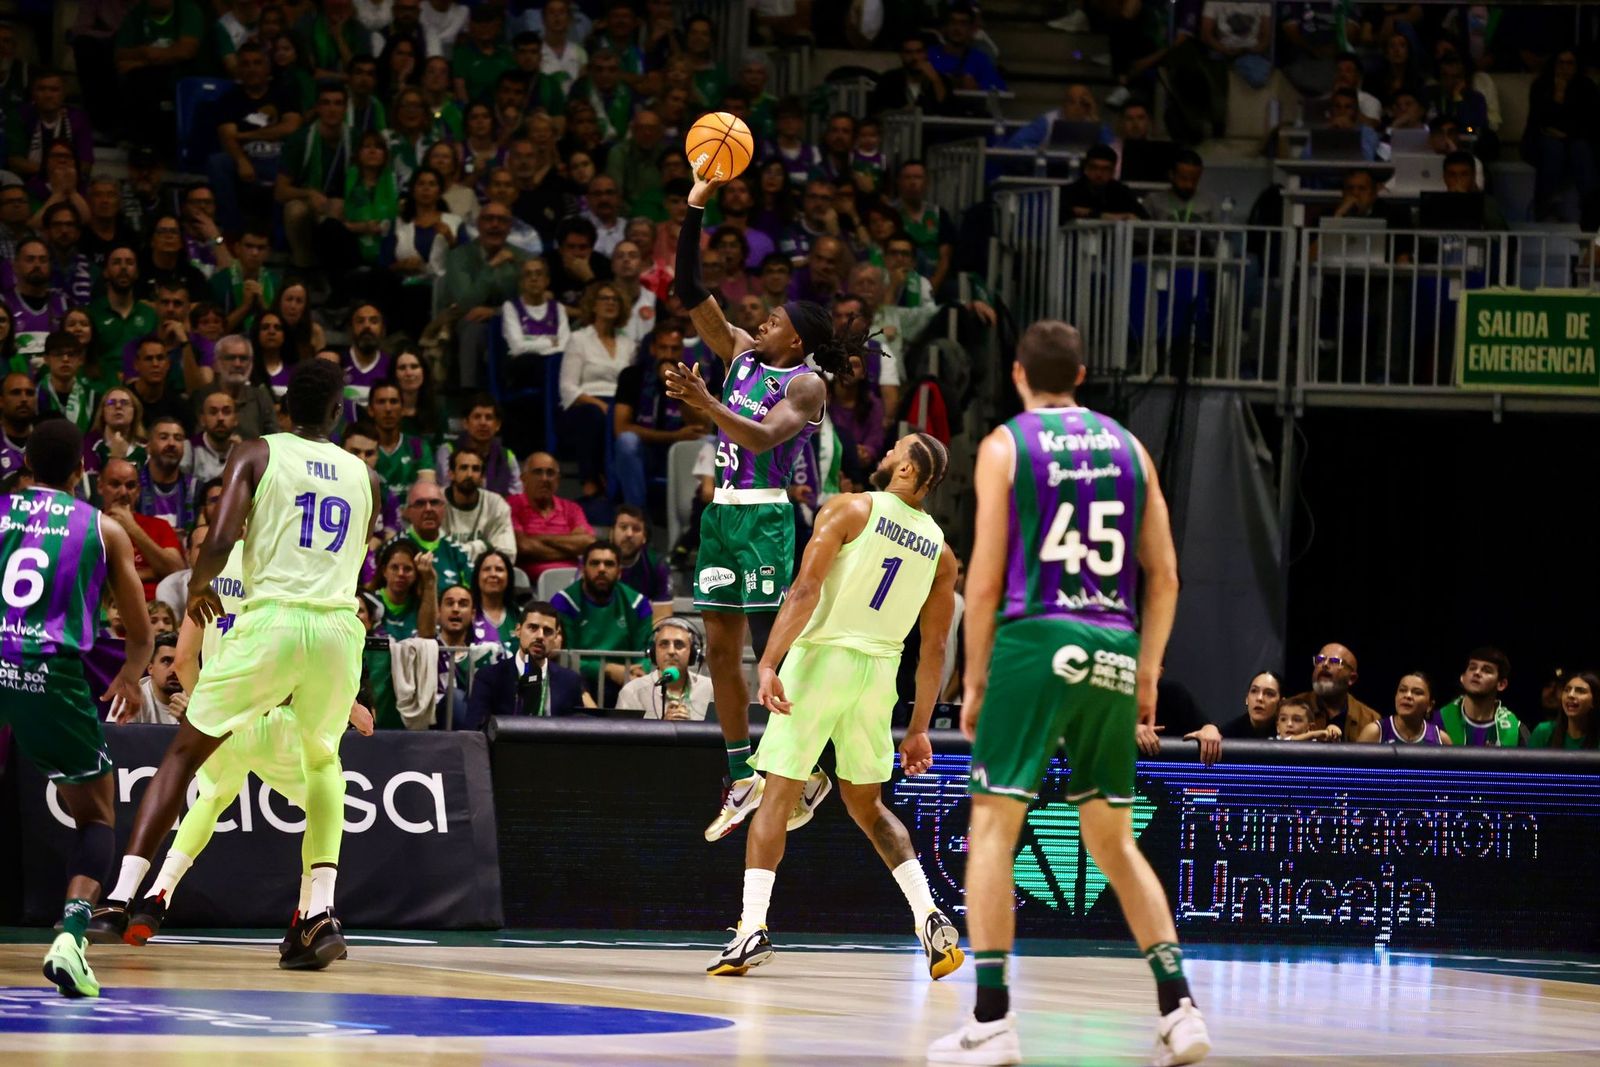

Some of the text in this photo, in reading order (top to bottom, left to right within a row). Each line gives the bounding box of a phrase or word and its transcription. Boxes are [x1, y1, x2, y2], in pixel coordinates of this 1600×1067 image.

[1478, 310, 1591, 339] SALIDA DE
[1469, 344, 1596, 374] EMERGENCIA
[1038, 428, 1121, 452] Kravish
[306, 461, 338, 481] FALL
[715, 441, 739, 471] 55
[10, 494, 76, 516] Taylor
[295, 491, 352, 553] 19
[875, 516, 938, 561] ANDERSON
[1039, 500, 1125, 576] 45
[2, 547, 49, 607] 6
[869, 556, 903, 611] 1
[0, 668, 46, 684] DEL SOL
[1177, 858, 1437, 944] Unicaja
